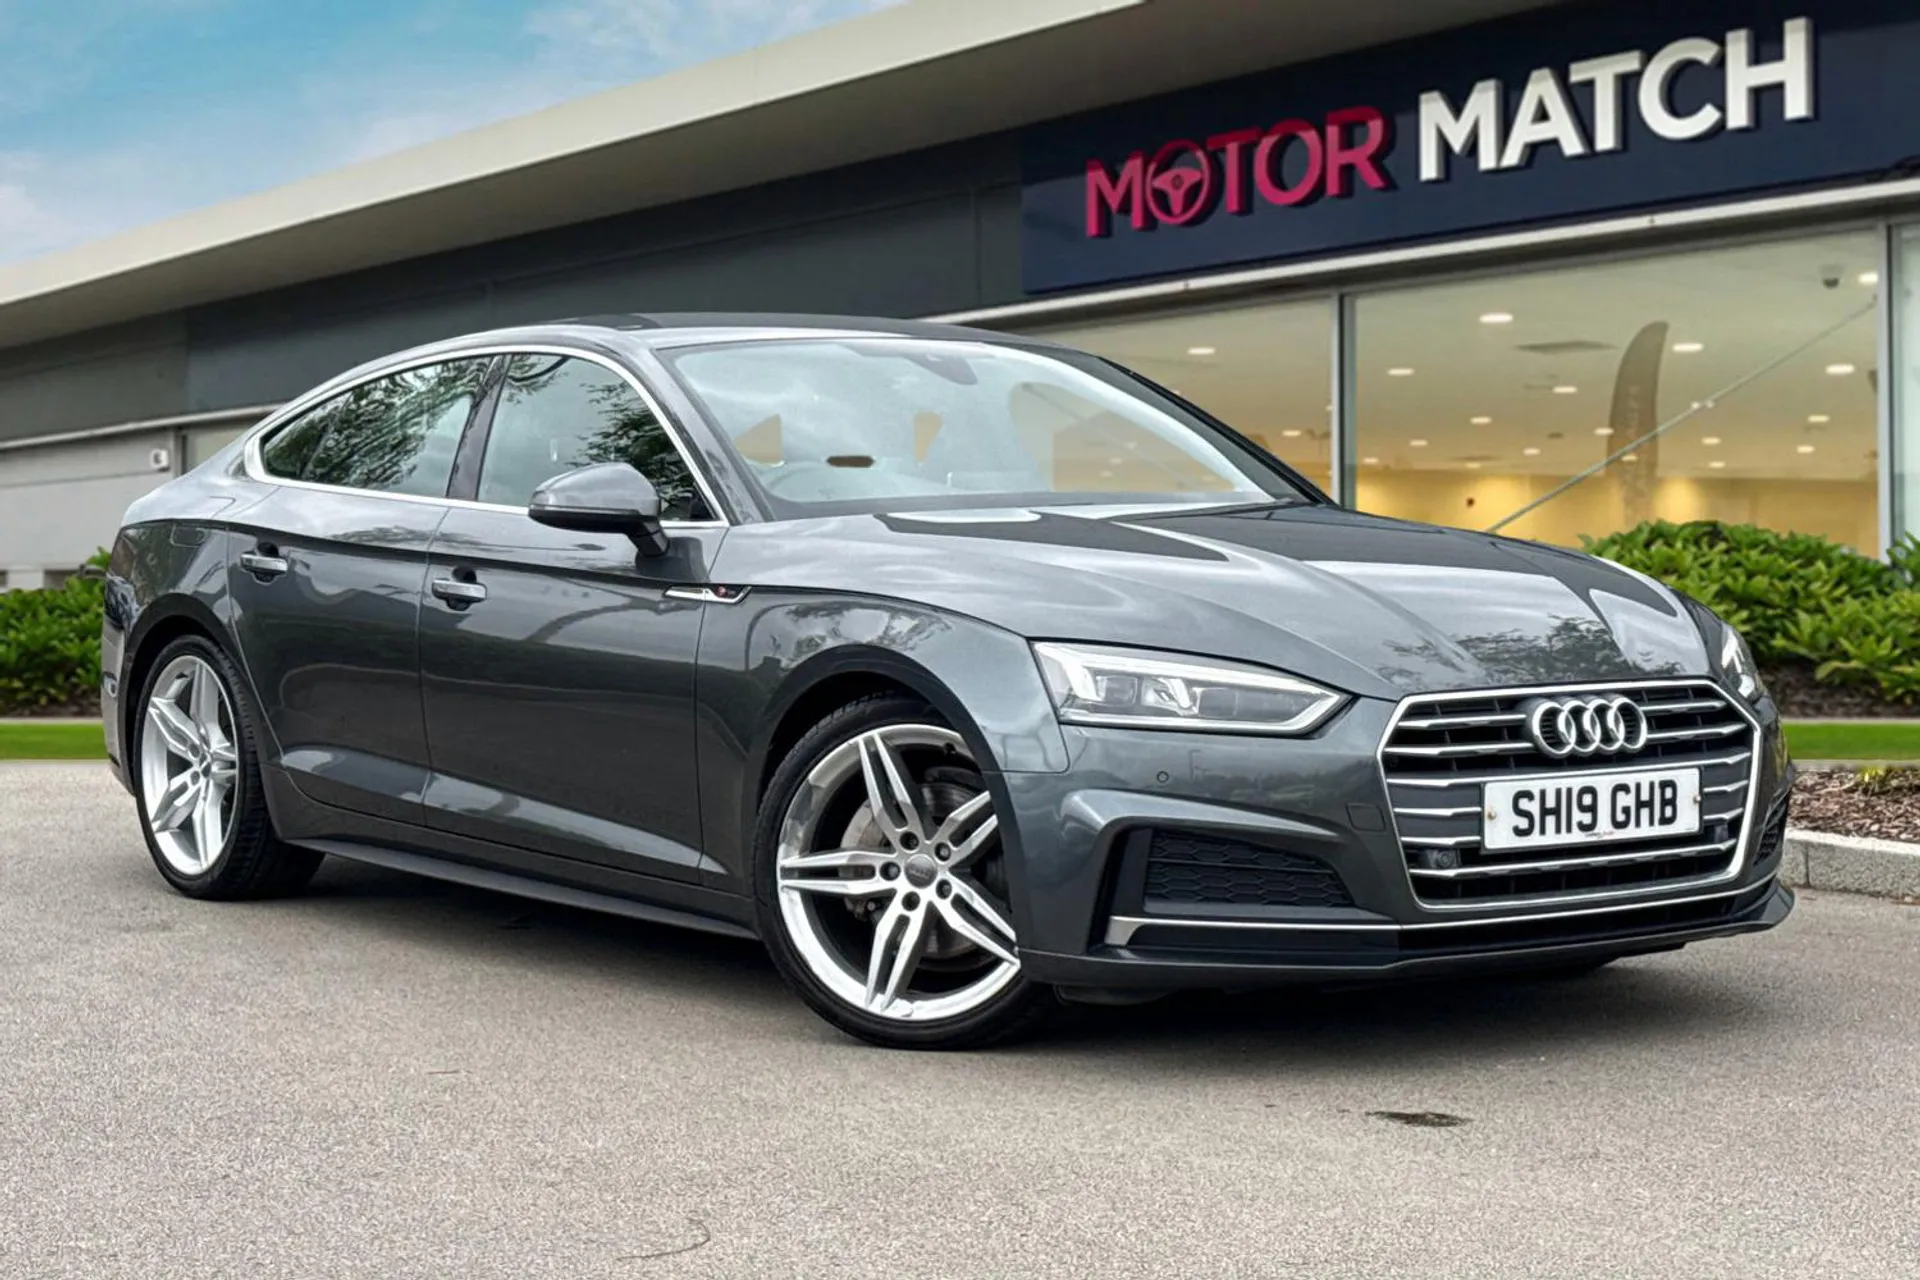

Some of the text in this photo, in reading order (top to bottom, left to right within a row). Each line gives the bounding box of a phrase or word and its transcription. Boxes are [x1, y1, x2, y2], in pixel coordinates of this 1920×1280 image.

[1086, 16, 1812, 238] MOTOR MATCH
[1512, 779, 1678, 837] SH19 GHB
